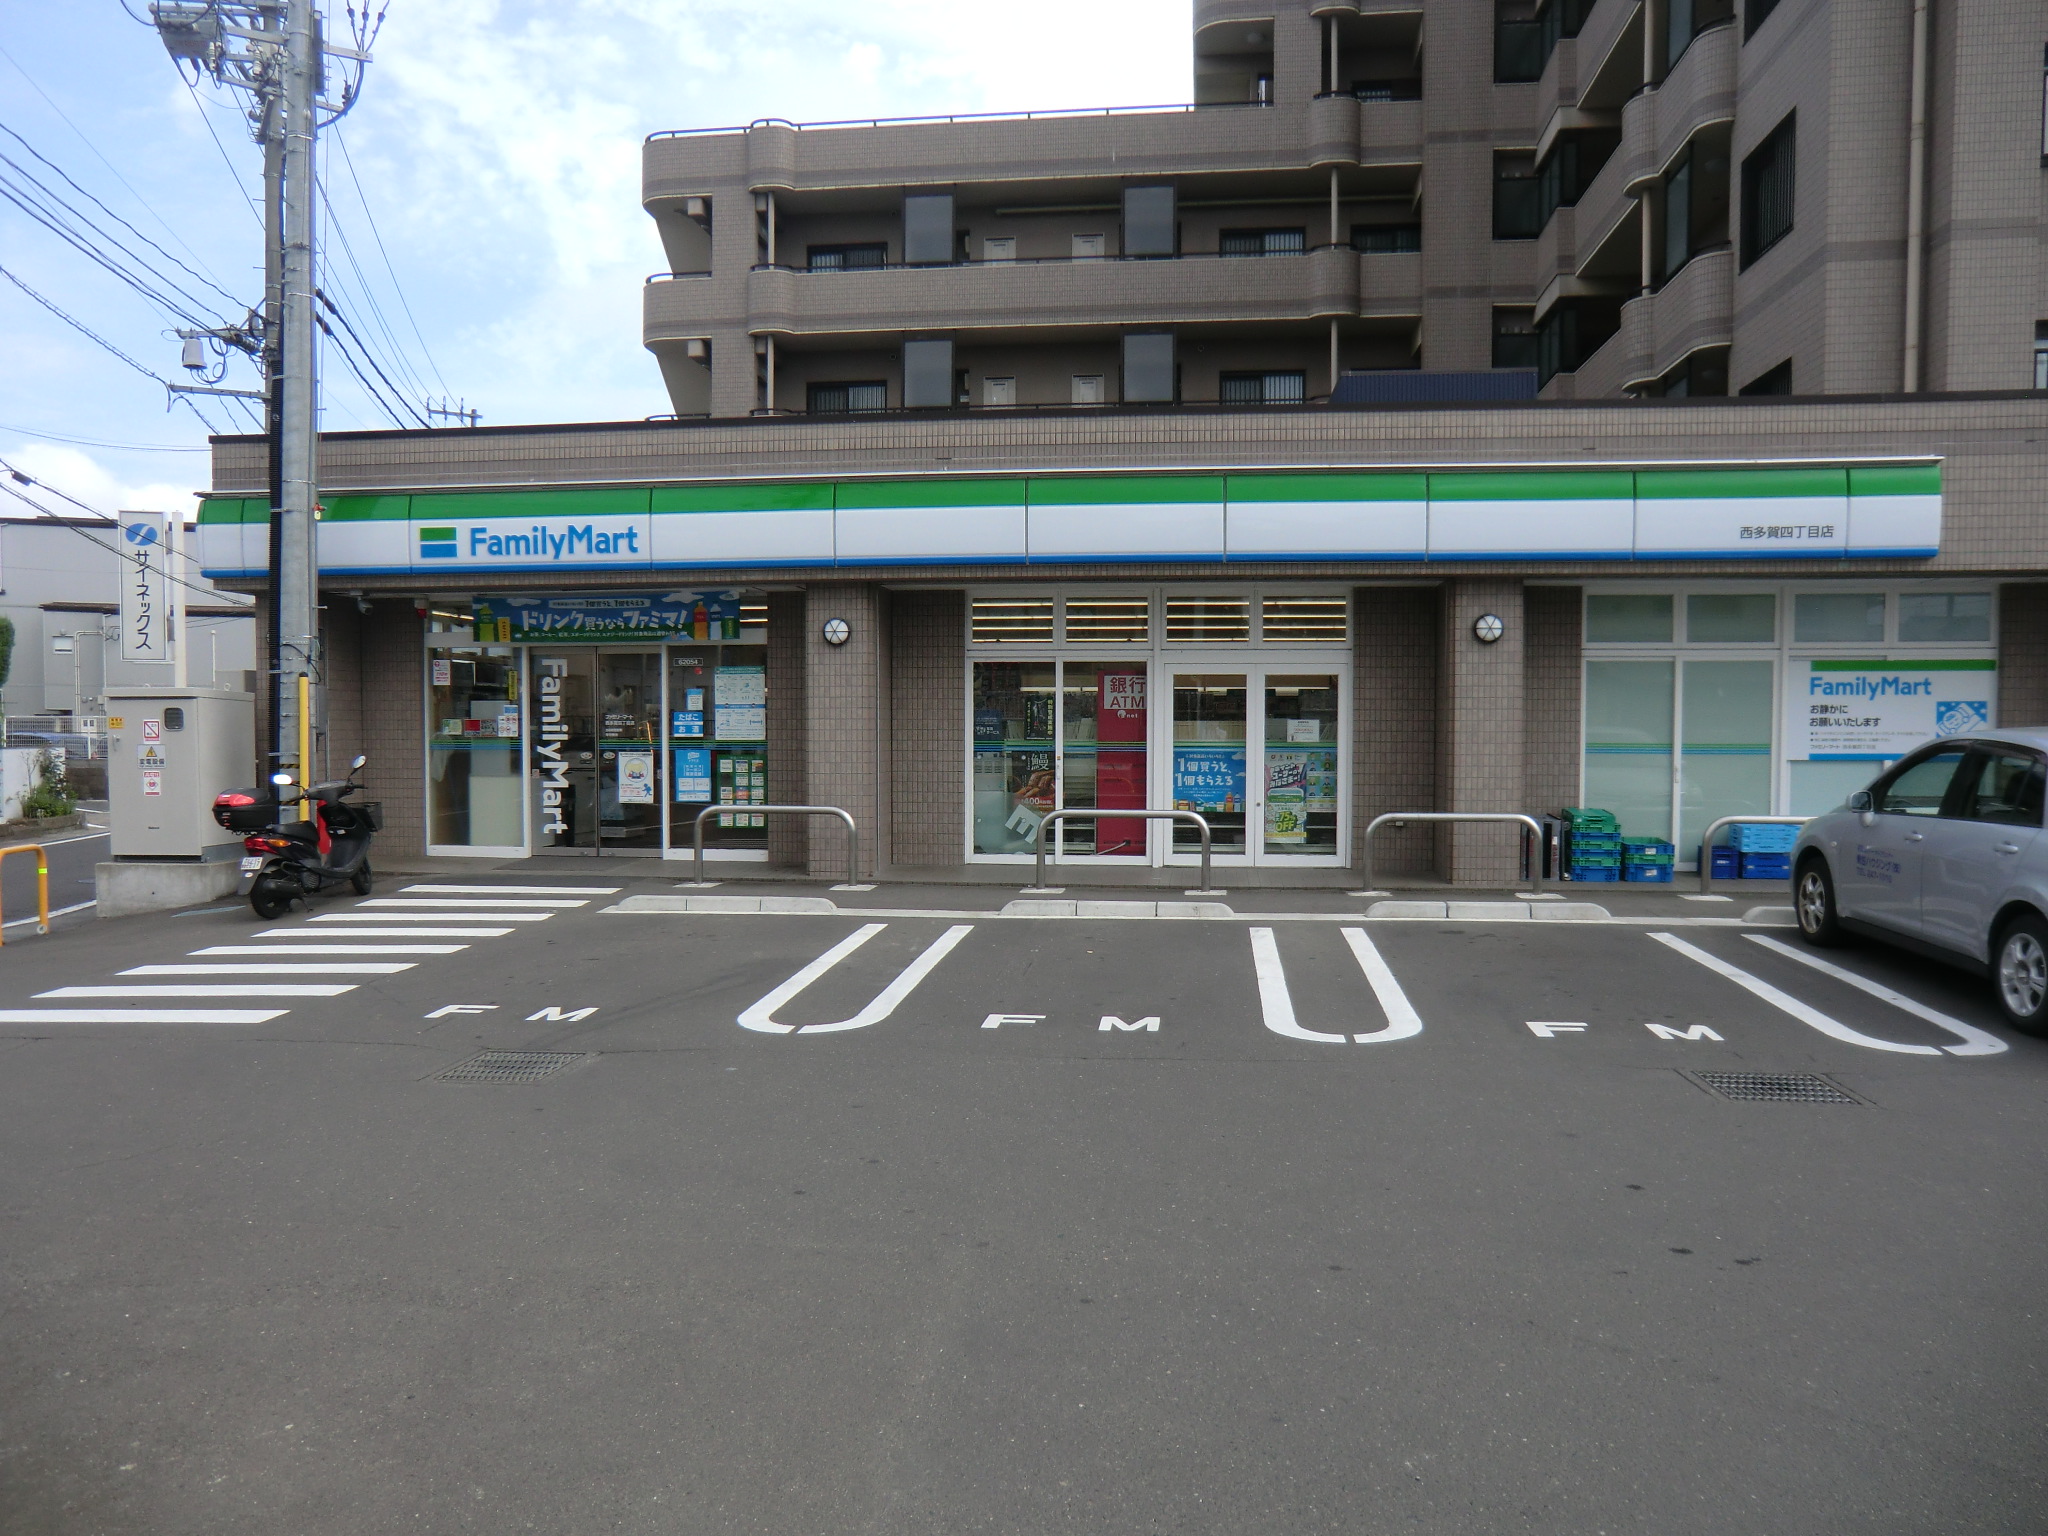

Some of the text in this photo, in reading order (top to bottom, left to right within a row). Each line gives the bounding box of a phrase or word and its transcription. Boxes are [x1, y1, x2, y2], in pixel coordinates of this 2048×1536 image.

[1740, 525, 1835, 539] 西多賀四丁目店
[470, 524, 639, 560] FamilyMart
[134, 549, 152, 650] サイネックス
[1110, 677, 1146, 693] 銀行
[1810, 676, 1932, 701] FamilyMart
[1110, 696, 1145, 708] ATM
[1810, 704, 1848, 715] お静かに
[678, 713, 699, 721] たばこ
[1809, 717, 1881, 728] お願いいたします
[537, 658, 569, 835] FamilyMart
[1177, 758, 1232, 774] 1個買うと、
[1175, 772, 1234, 787] 1個もらえる
[1275, 821, 1296, 832] OFF
[423, 1004, 600, 1022] F M
[980, 1013, 1161, 1032] F M
[1525, 1021, 1725, 1041] F M
